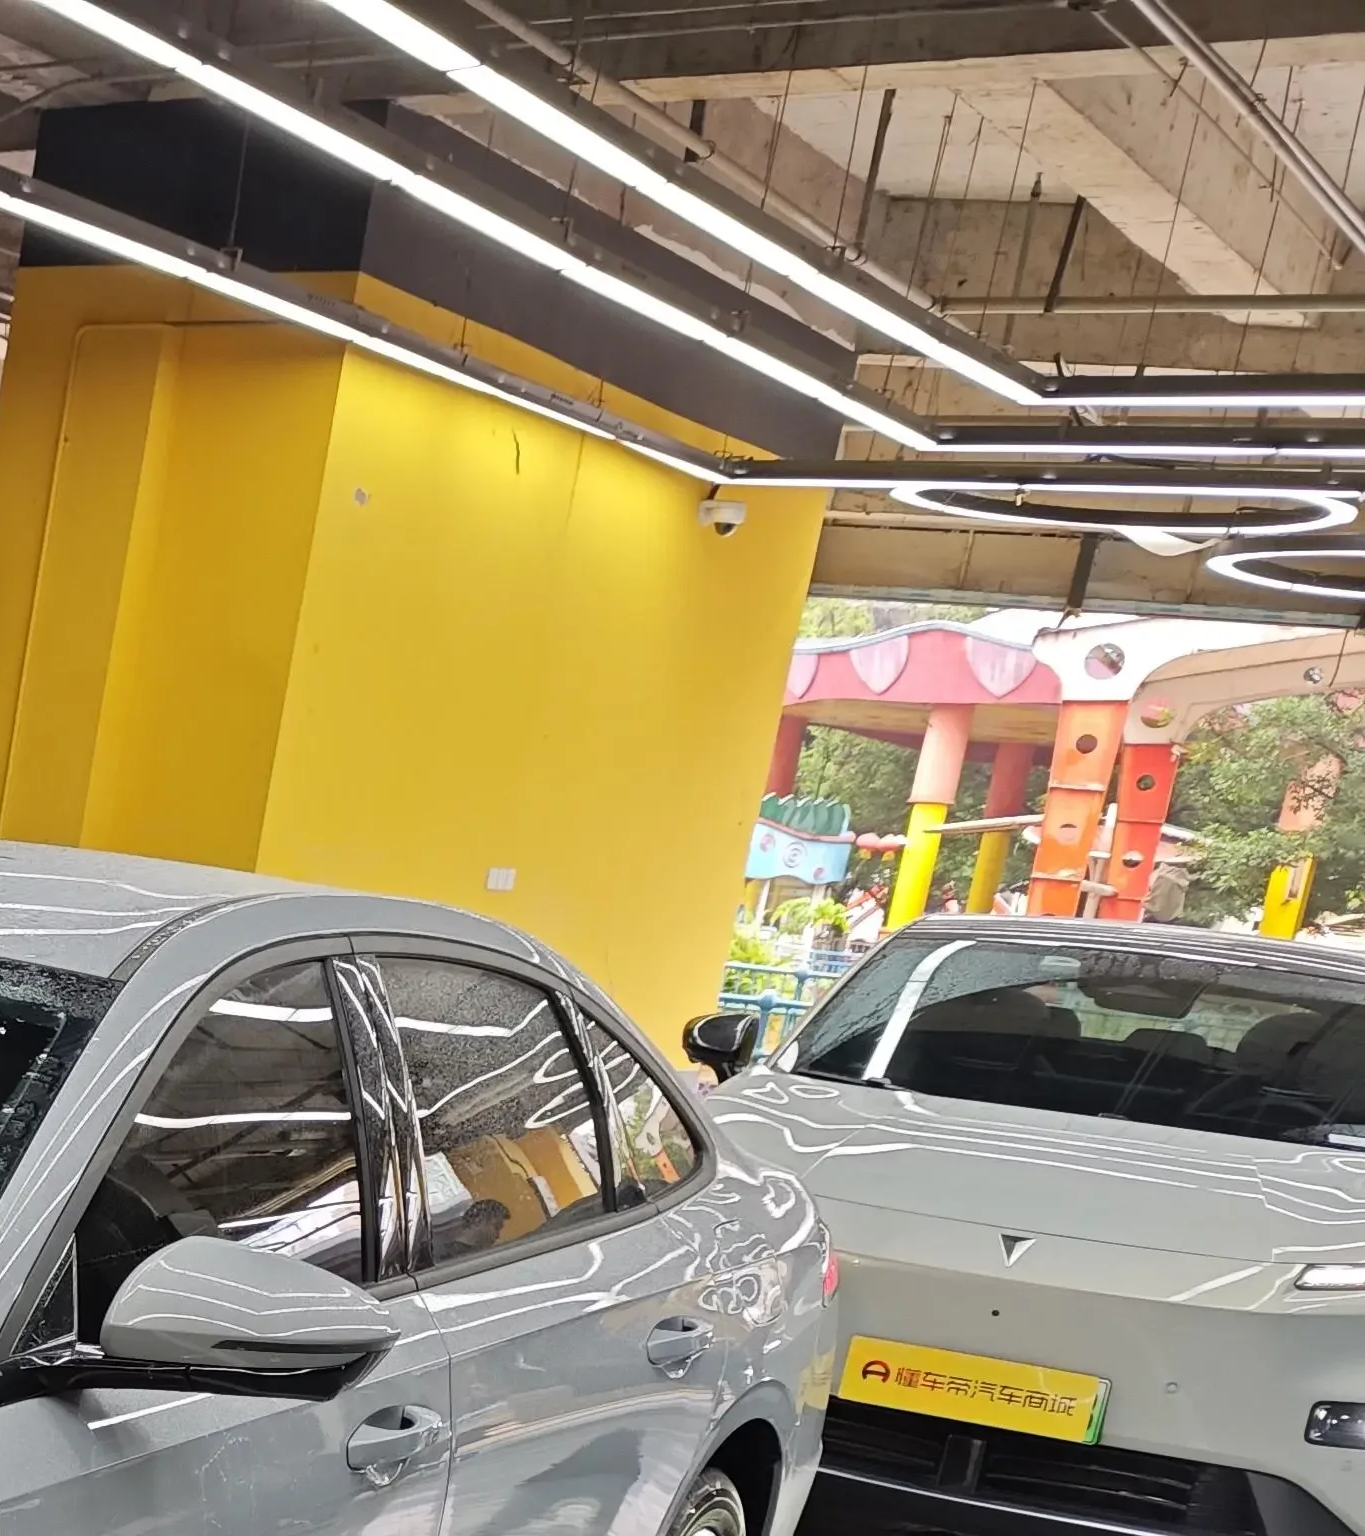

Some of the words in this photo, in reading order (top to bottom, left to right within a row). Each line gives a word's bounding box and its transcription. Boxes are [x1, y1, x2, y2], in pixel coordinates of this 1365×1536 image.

[895, 1367, 1078, 1416] 懂车帝汽车商城
